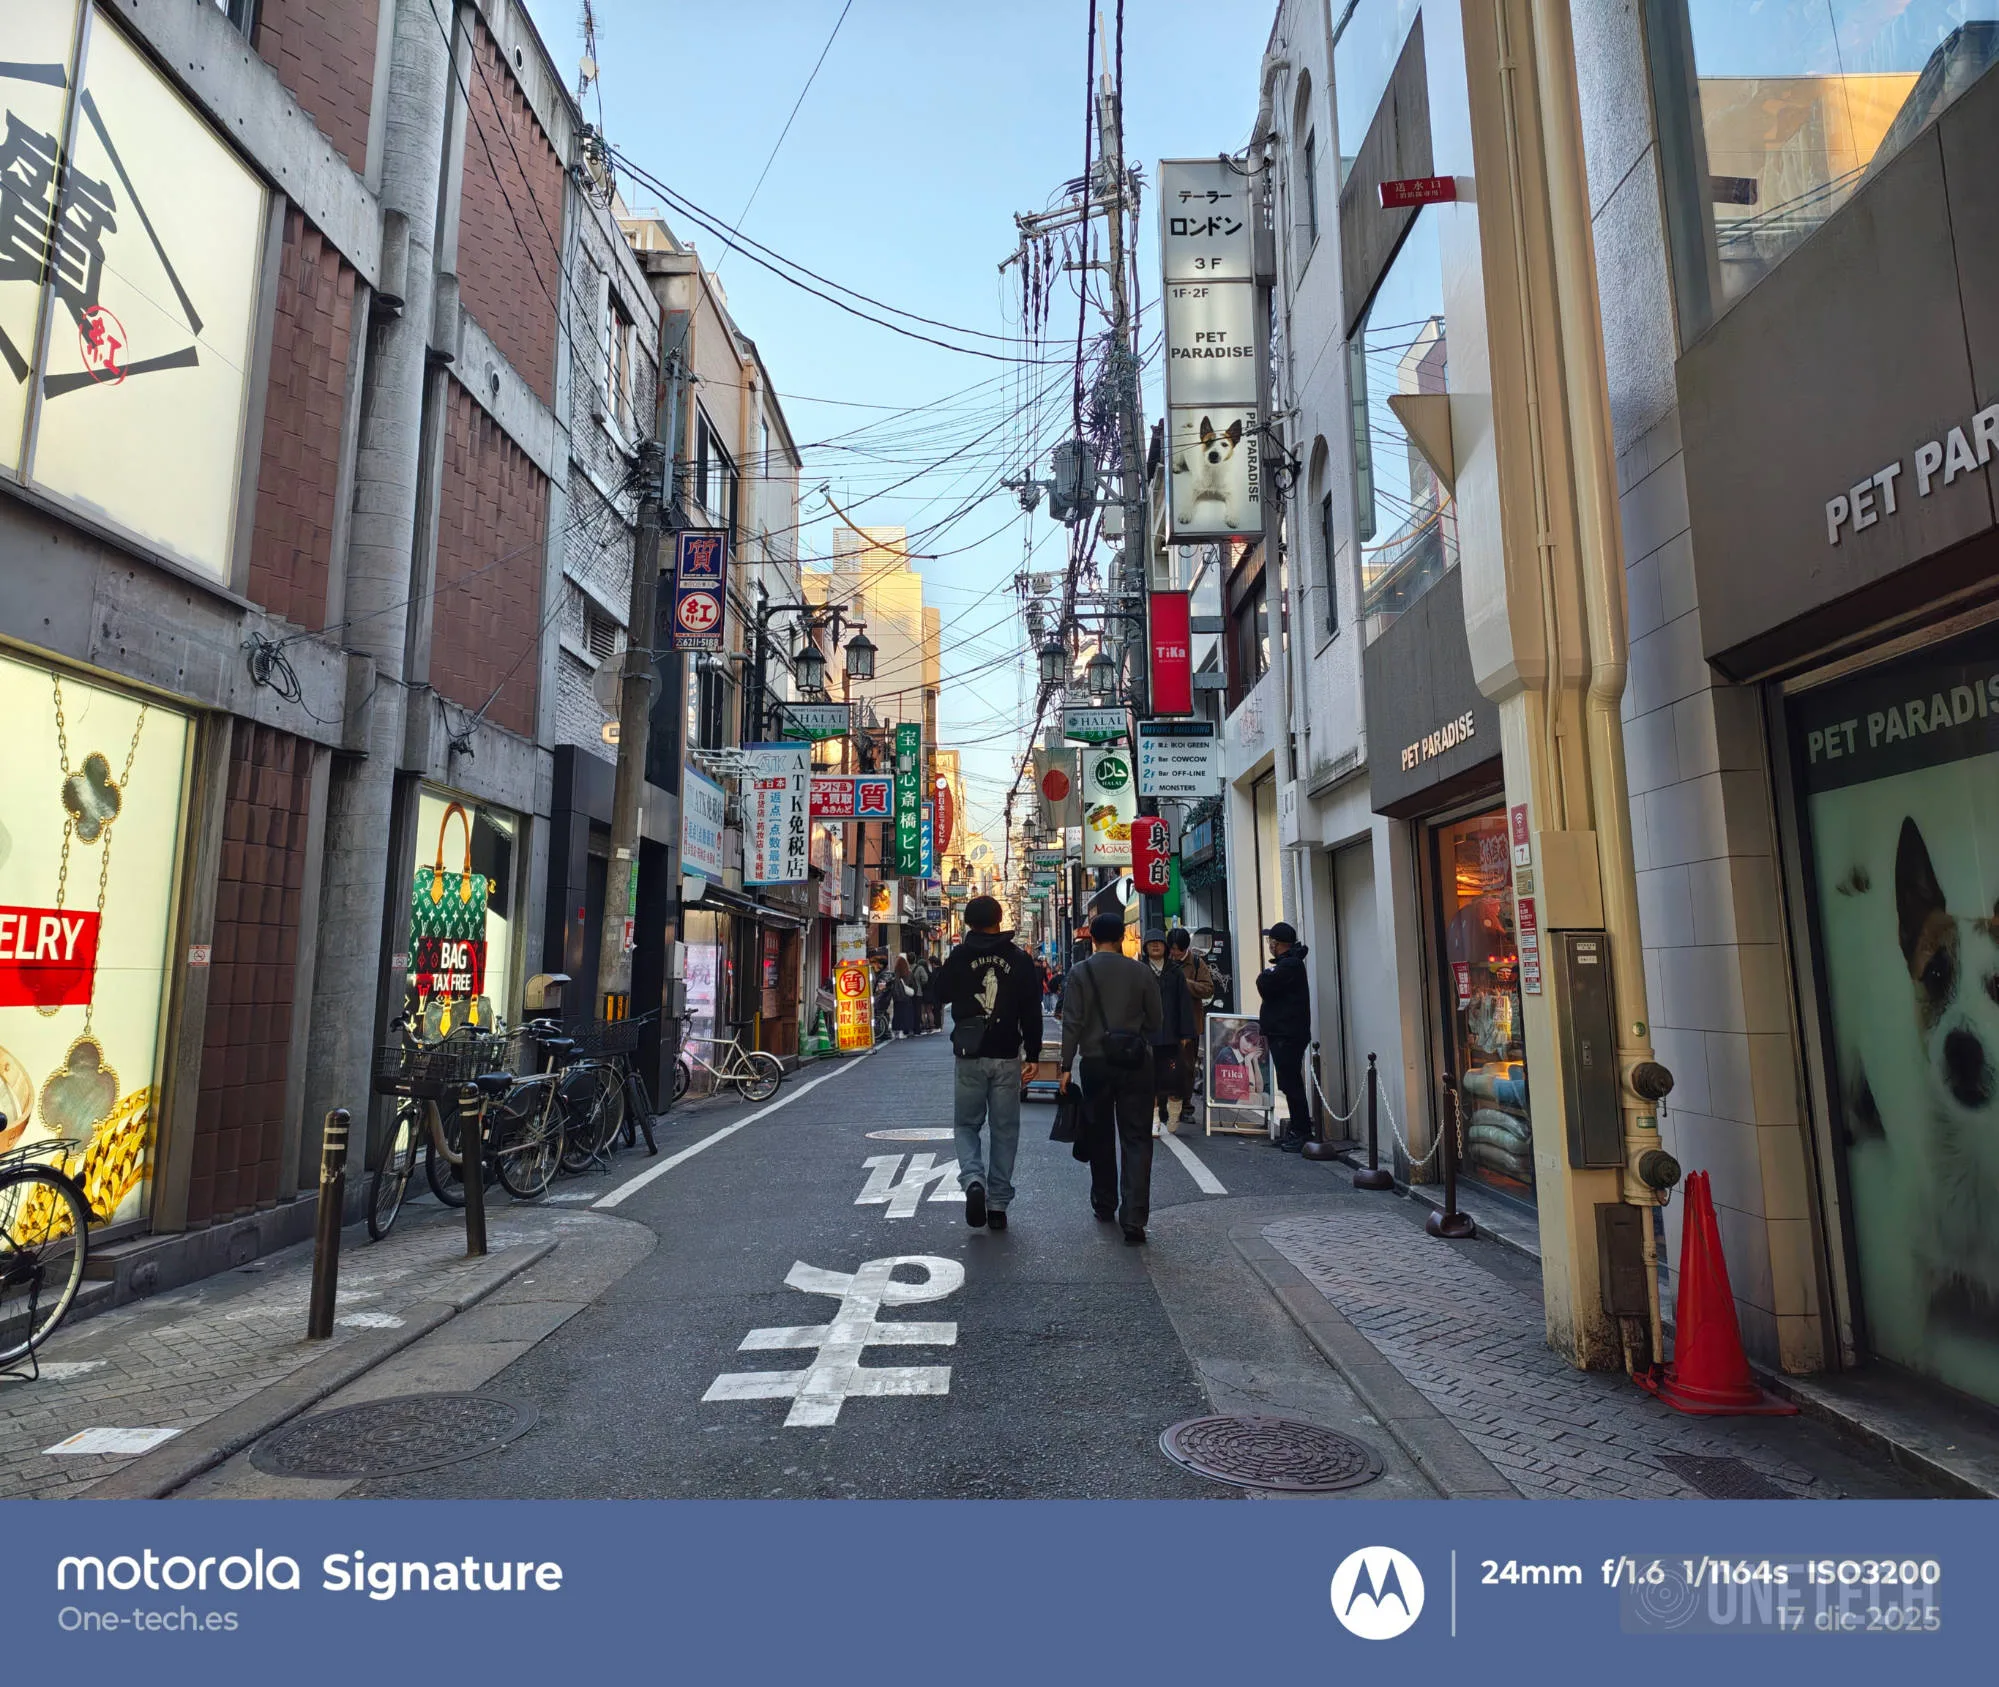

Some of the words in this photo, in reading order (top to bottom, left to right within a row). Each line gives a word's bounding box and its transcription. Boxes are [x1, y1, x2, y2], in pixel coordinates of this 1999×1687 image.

[1178, 191, 1232, 204] テーラー
[1170, 216, 1243, 237] ロンドン
[1195, 332, 1227, 343] PET
[1171, 346, 1254, 359] PARADISE
[1247, 440, 1259, 503] PARADISE
[1825, 461, 1902, 545] PET
[687, 539, 718, 572] 質
[685, 598, 713, 625] 紅
[800, 714, 845, 723] HALAL
[1081, 716, 1125, 726] HALAL
[1401, 742, 1420, 772] PET
[1422, 709, 1475, 761] PARADISE
[1808, 718, 1859, 764] PET
[859, 782, 888, 813] 質
[0, 913, 85, 960] ELRY
[440, 942, 467, 969] BAG
[433, 973, 449, 991] TAX
[450, 973, 471, 991] FREE
[1221, 1069, 1243, 1079] Tika
